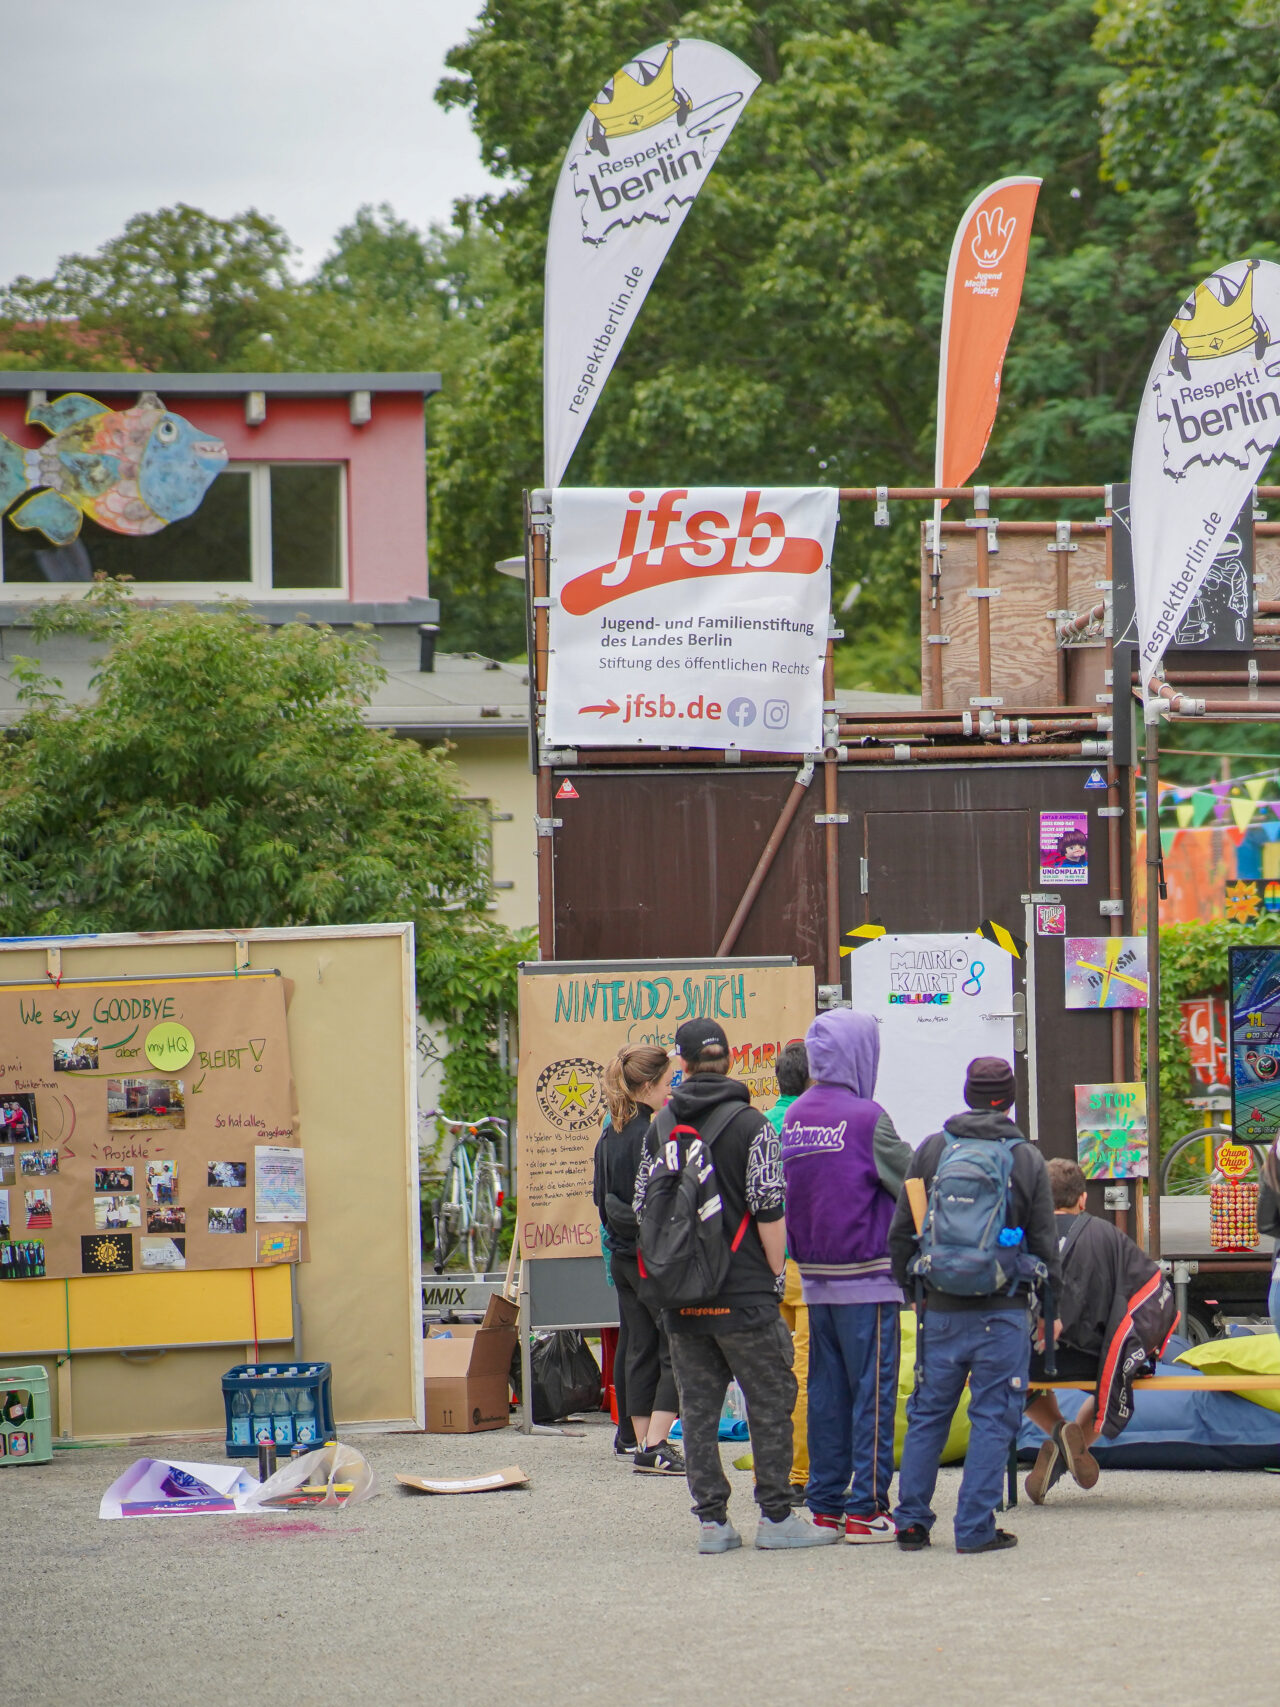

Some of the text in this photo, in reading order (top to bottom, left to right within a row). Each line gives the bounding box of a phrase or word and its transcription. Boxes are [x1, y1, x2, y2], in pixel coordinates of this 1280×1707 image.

[598, 134, 681, 178] Respekt!
[590, 148, 703, 212] berlin
[568, 265, 643, 414] respektberlin.de
[1180, 368, 1260, 404] Respekt!
[601, 489, 786, 587] jfsb
[1143, 512, 1222, 663] respektberlin.de
[601, 616, 814, 636] Jugend- und Familienstiftung
[601, 634, 732, 647] des Landes Berlin
[600, 656, 810, 675] Stiftung des öffentlichen Rechts
[623, 694, 722, 723] jfsb.de
[890, 950, 968, 970] MARIO
[891, 961, 985, 996] KART 8
[889, 993, 951, 1004] DELUXE
[20, 997, 184, 1029] We say GOODBYE,
[115, 1048, 141, 1058] aber
[147, 1045, 165, 1056] my
[168, 1036, 190, 1053] HQ
[1090, 1093, 1136, 1109] STOP
[214, 1113, 266, 1128] So hat alles
[540, 1097, 600, 1131] MARIO KART
[565, 1133, 589, 1141] Modus
[102, 1146, 149, 1161] Projekte
[1089, 1149, 1141, 1163] RACISM
[1220, 1157, 1247, 1169] Chups
[1221, 1148, 1247, 1159] Chupa
[525, 1223, 599, 1249] ENDGAMES:
